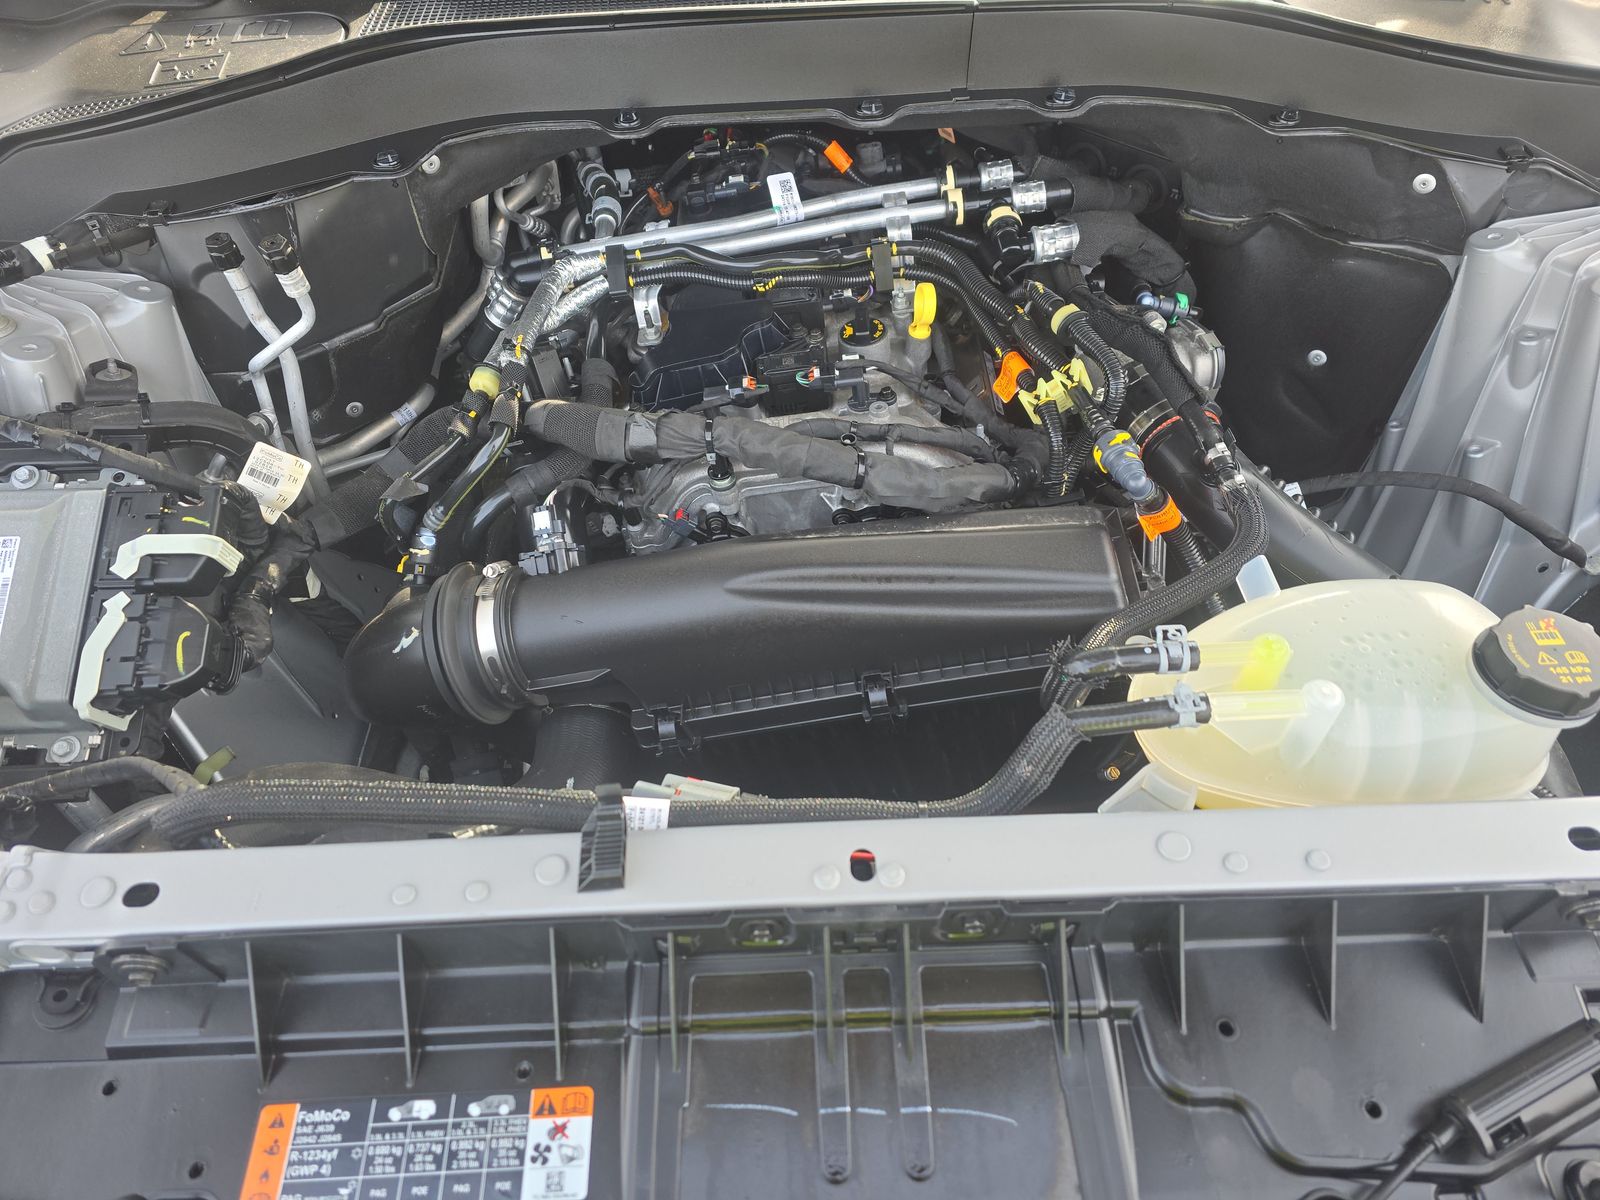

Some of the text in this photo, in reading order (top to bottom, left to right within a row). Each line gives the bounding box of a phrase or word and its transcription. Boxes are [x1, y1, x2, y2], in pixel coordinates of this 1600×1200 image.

[294, 460, 304, 469] TH
[288, 474, 298, 485] TH
[276, 494, 288, 503] TH
[264, 506, 276, 515] TH
[1559, 674, 1593, 684] 21 psi
[297, 1108, 351, 1123] FoMoCo
[289, 1148, 339, 1162] R-1234yf
[286, 1163, 332, 1178] (GWP 4)
